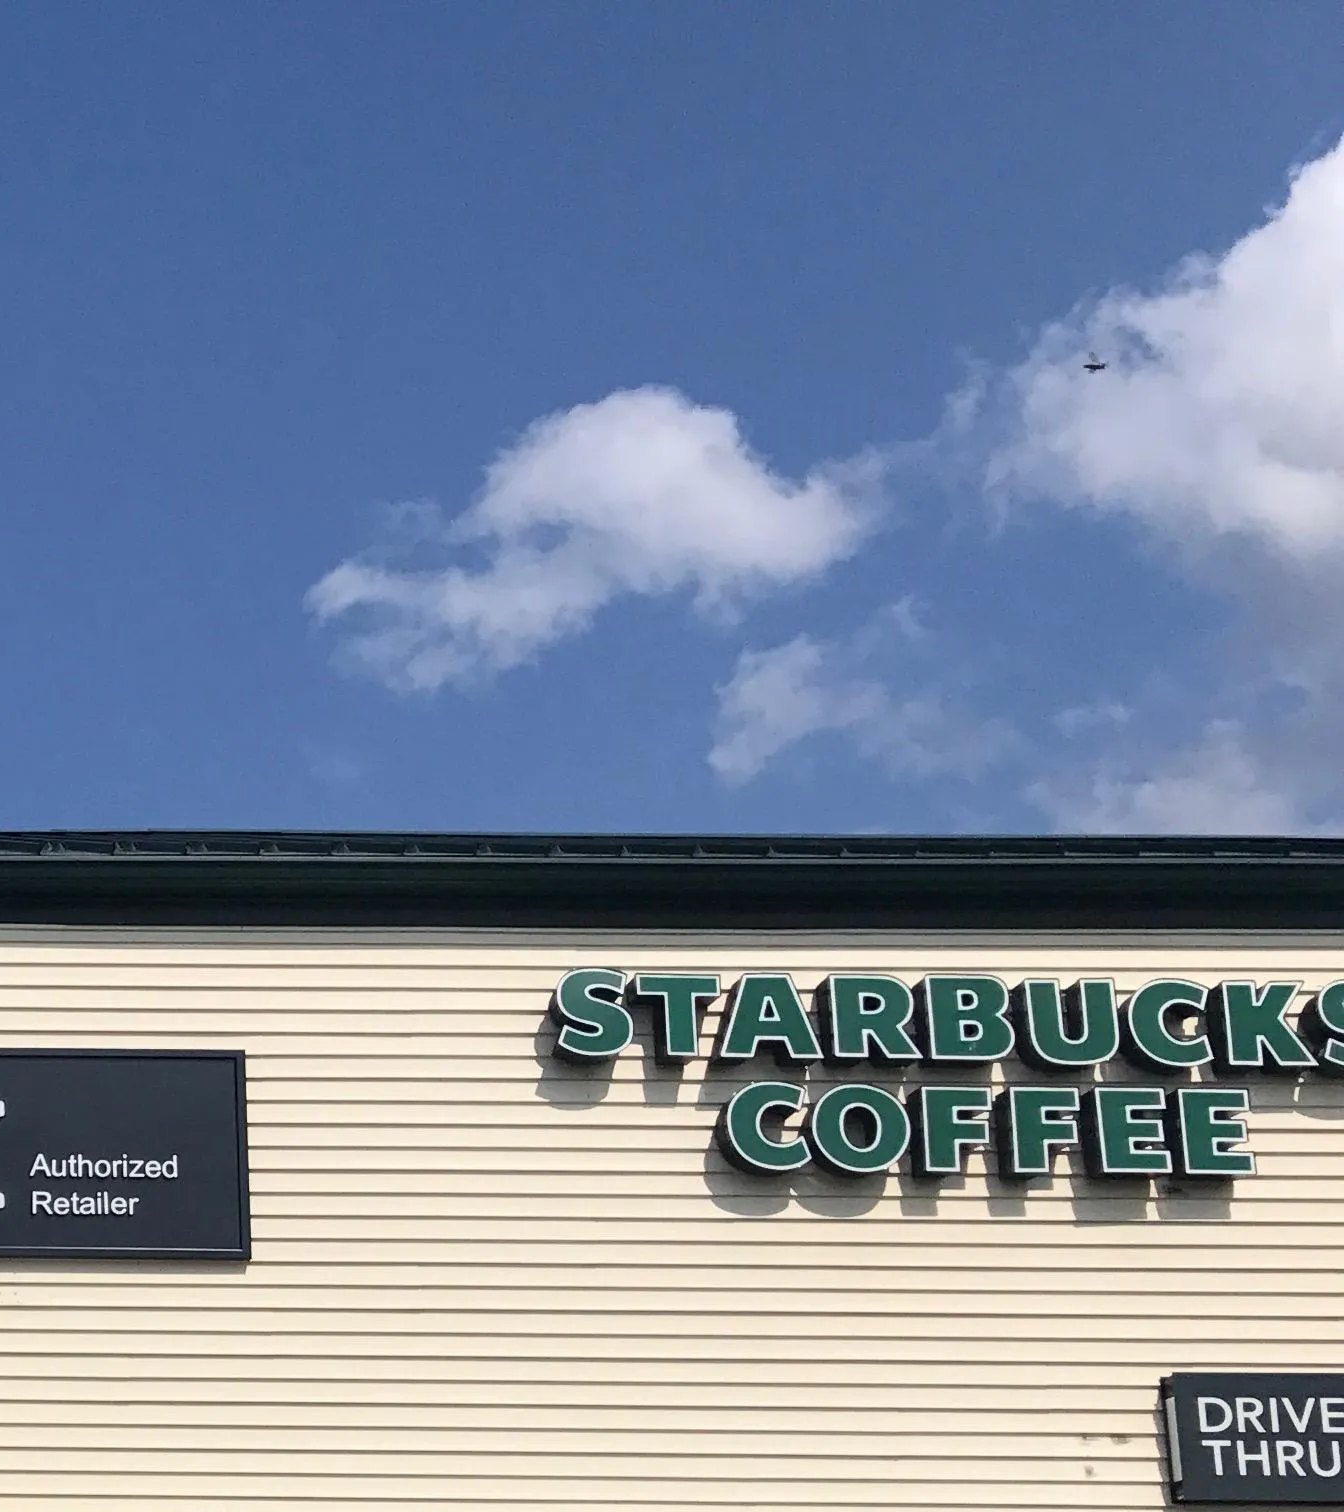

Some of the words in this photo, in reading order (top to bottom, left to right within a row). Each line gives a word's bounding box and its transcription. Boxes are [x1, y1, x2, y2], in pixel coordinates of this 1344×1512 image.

[552, 967, 1344, 1070] STARBUCK
[722, 1081, 1257, 1177] COFFEE
[28, 1153, 179, 1180] Authorized
[30, 1191, 140, 1216] Retailer
[1197, 1396, 1344, 1435] DRIVE
[1201, 1439, 1343, 1479] THRU
